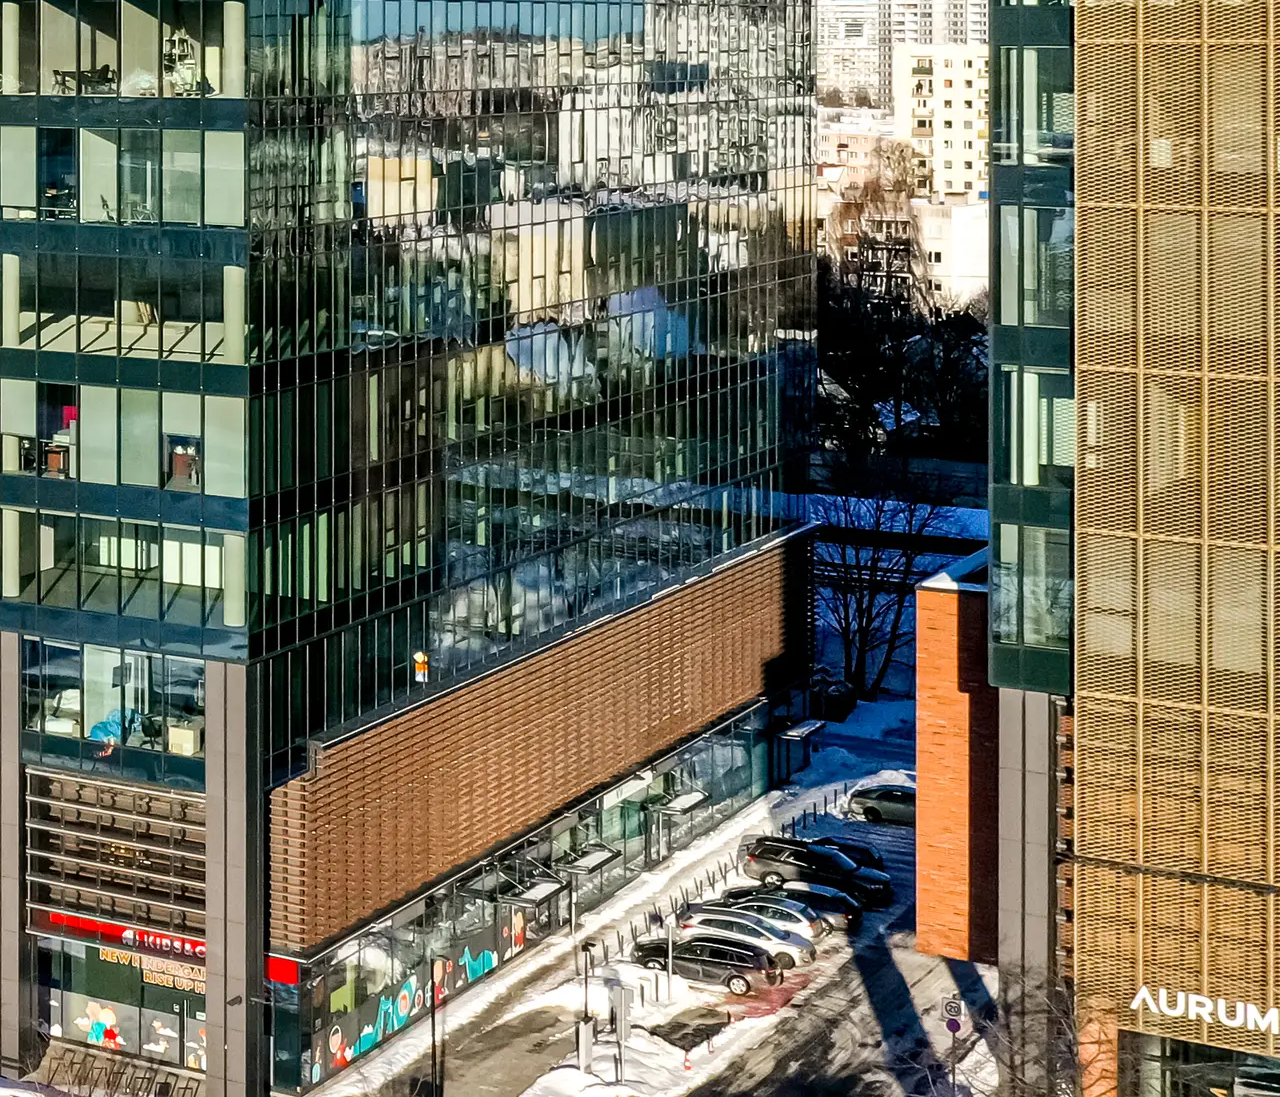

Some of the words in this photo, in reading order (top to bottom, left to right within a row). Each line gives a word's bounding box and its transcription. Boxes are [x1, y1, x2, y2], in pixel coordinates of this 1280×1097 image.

[100, 947, 131, 965] NEW
[143, 969, 174, 987] RISE
[174, 977, 194, 992] UP
[948, 1004, 960, 1014] 20
[1130, 985, 1279, 1034] AURUM
